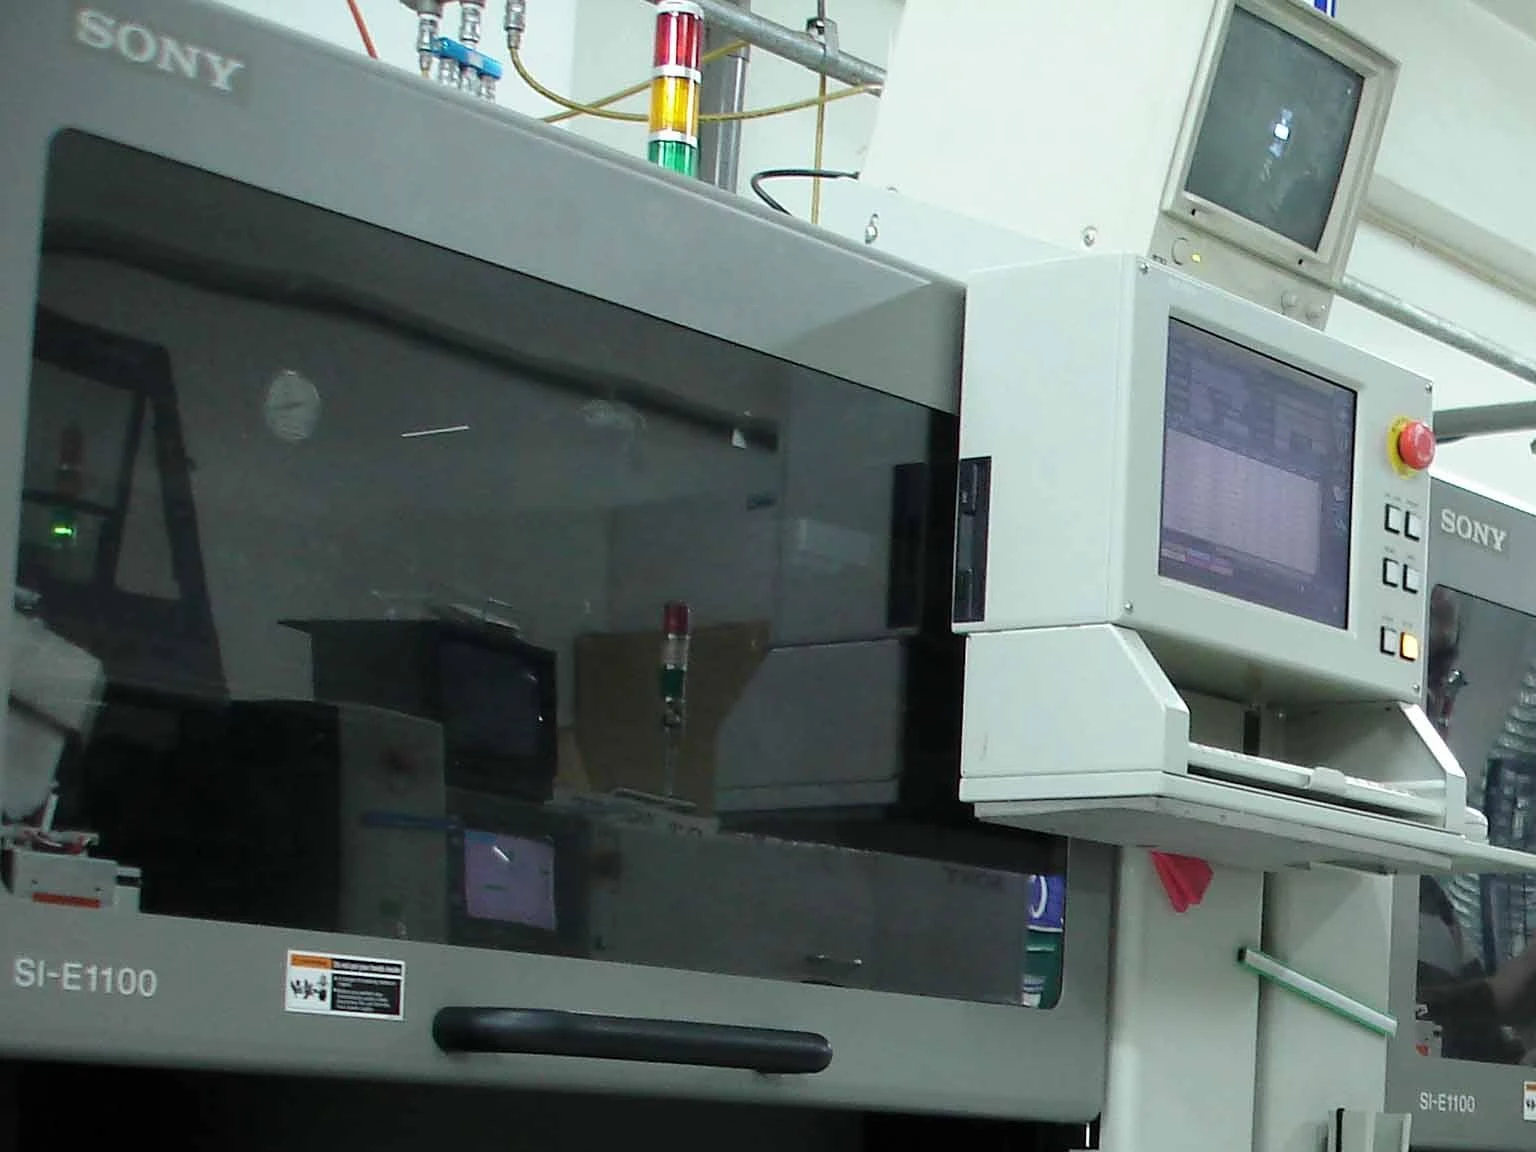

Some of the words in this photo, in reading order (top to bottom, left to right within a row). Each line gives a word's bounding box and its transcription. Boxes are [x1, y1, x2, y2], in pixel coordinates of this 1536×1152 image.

[75, 8, 245, 92] SONY
[1440, 508, 1507, 552] SONY
[15, 957, 157, 997] SI-E1100
[1420, 1092, 1476, 1113] SI-E1100
